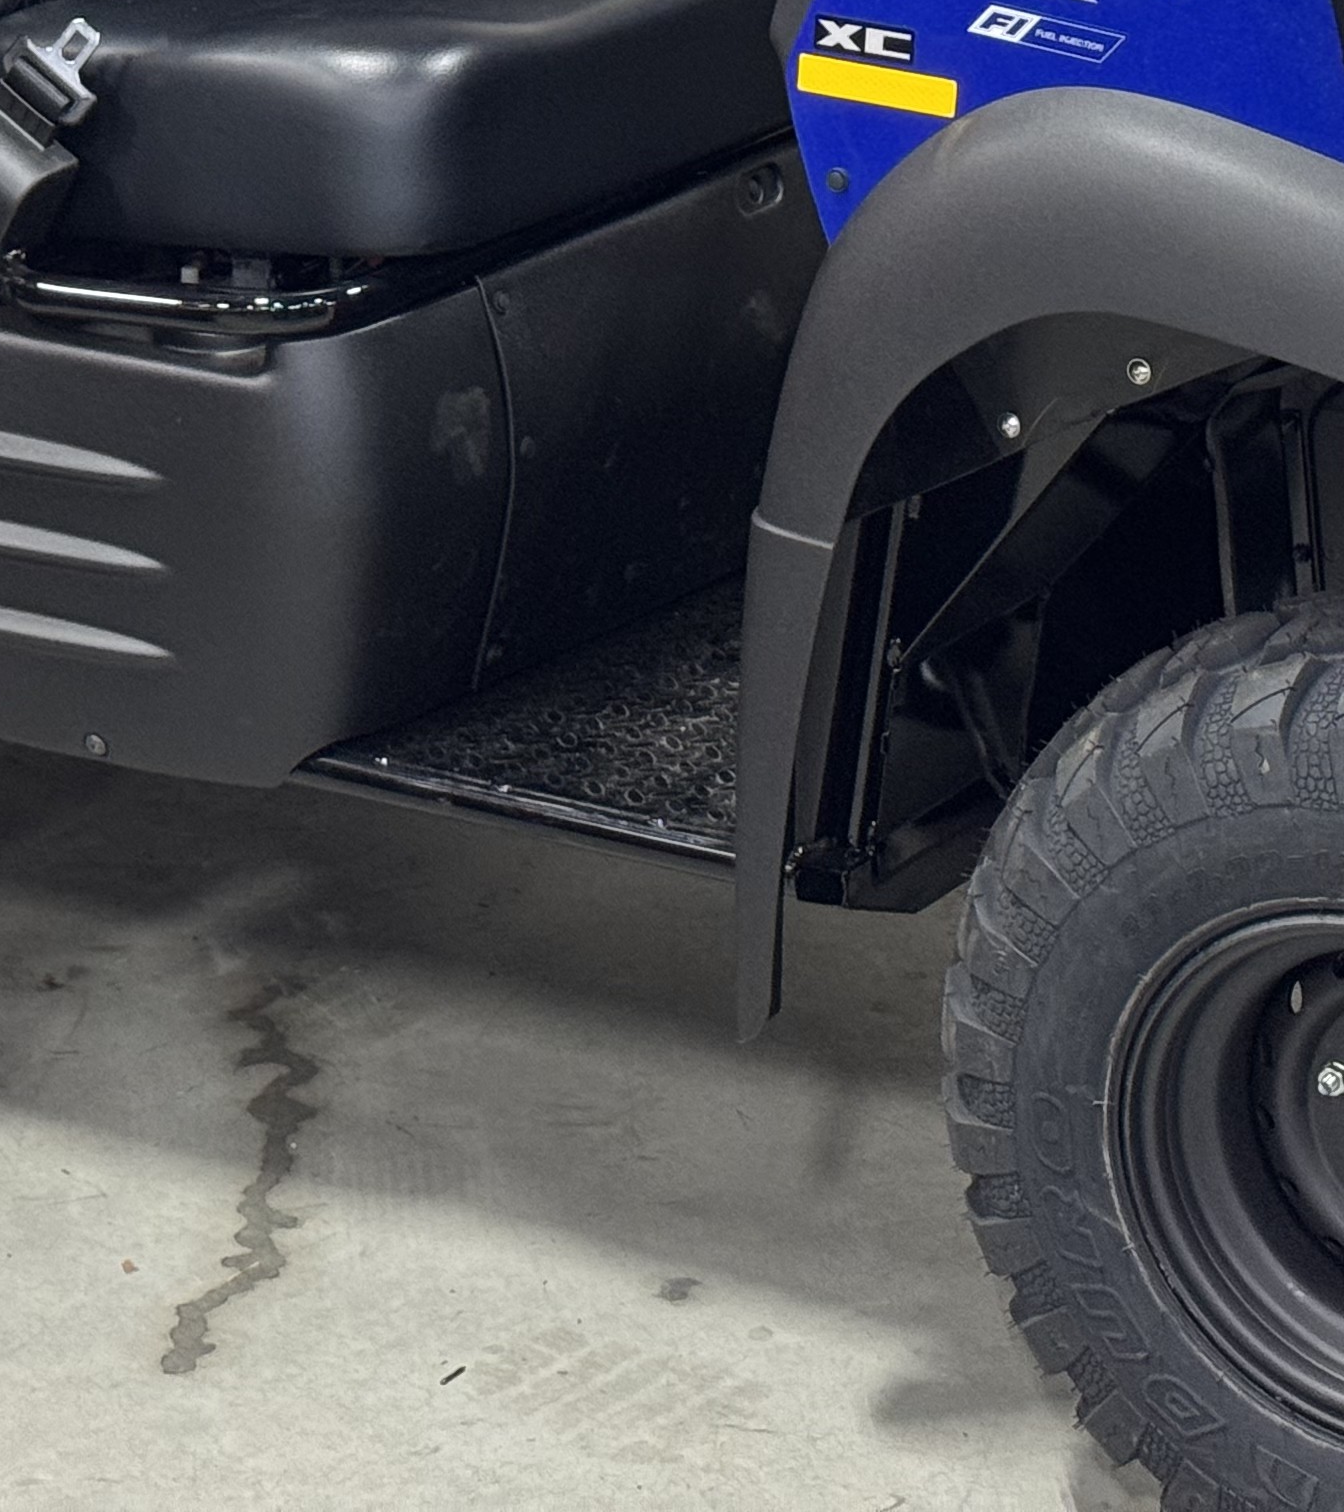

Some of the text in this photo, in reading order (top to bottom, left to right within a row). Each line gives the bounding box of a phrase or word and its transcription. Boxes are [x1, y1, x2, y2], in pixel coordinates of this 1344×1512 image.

[817, 18, 913, 62] XC
[980, 11, 1029, 37] FI
[1029, 1090, 1227, 1438] DURO
